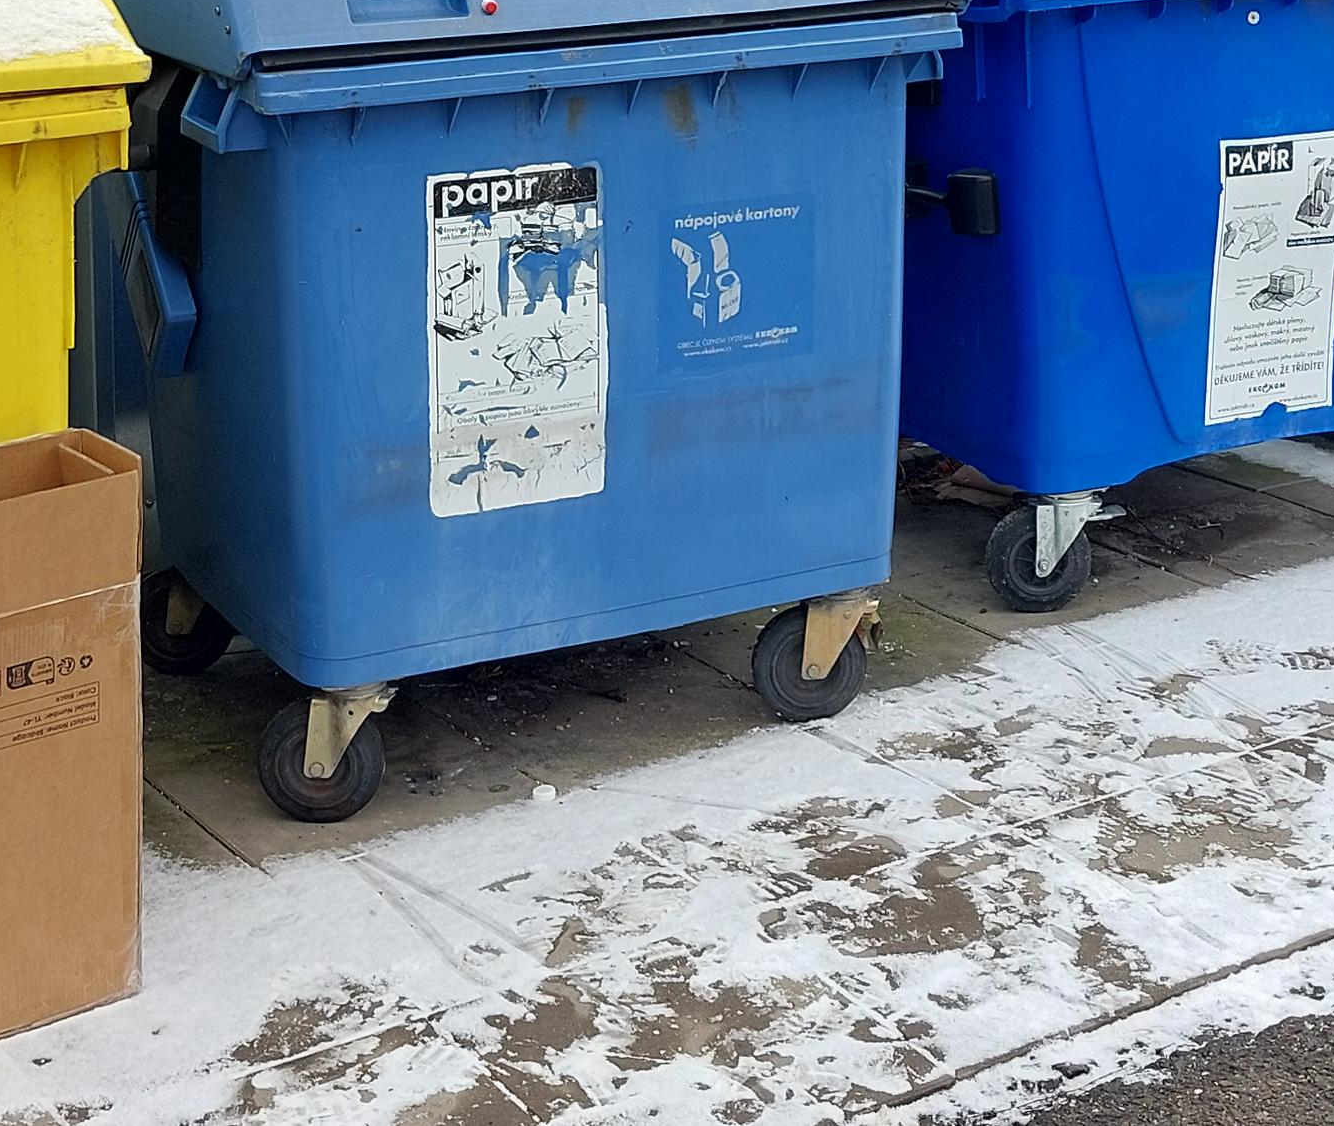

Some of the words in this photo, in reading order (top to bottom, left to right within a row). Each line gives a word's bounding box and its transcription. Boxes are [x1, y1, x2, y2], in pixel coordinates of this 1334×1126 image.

[1228, 143, 1290, 175] PAPÍR
[675, 209, 743, 230] nápojové
[746, 206, 800, 221] kartony
[1214, 370, 1257, 386] DĚKUJEME
[1280, 363, 1289, 375] ŽE
[56, 692, 74, 702] Black
[75, 701, 96, 712] Model
